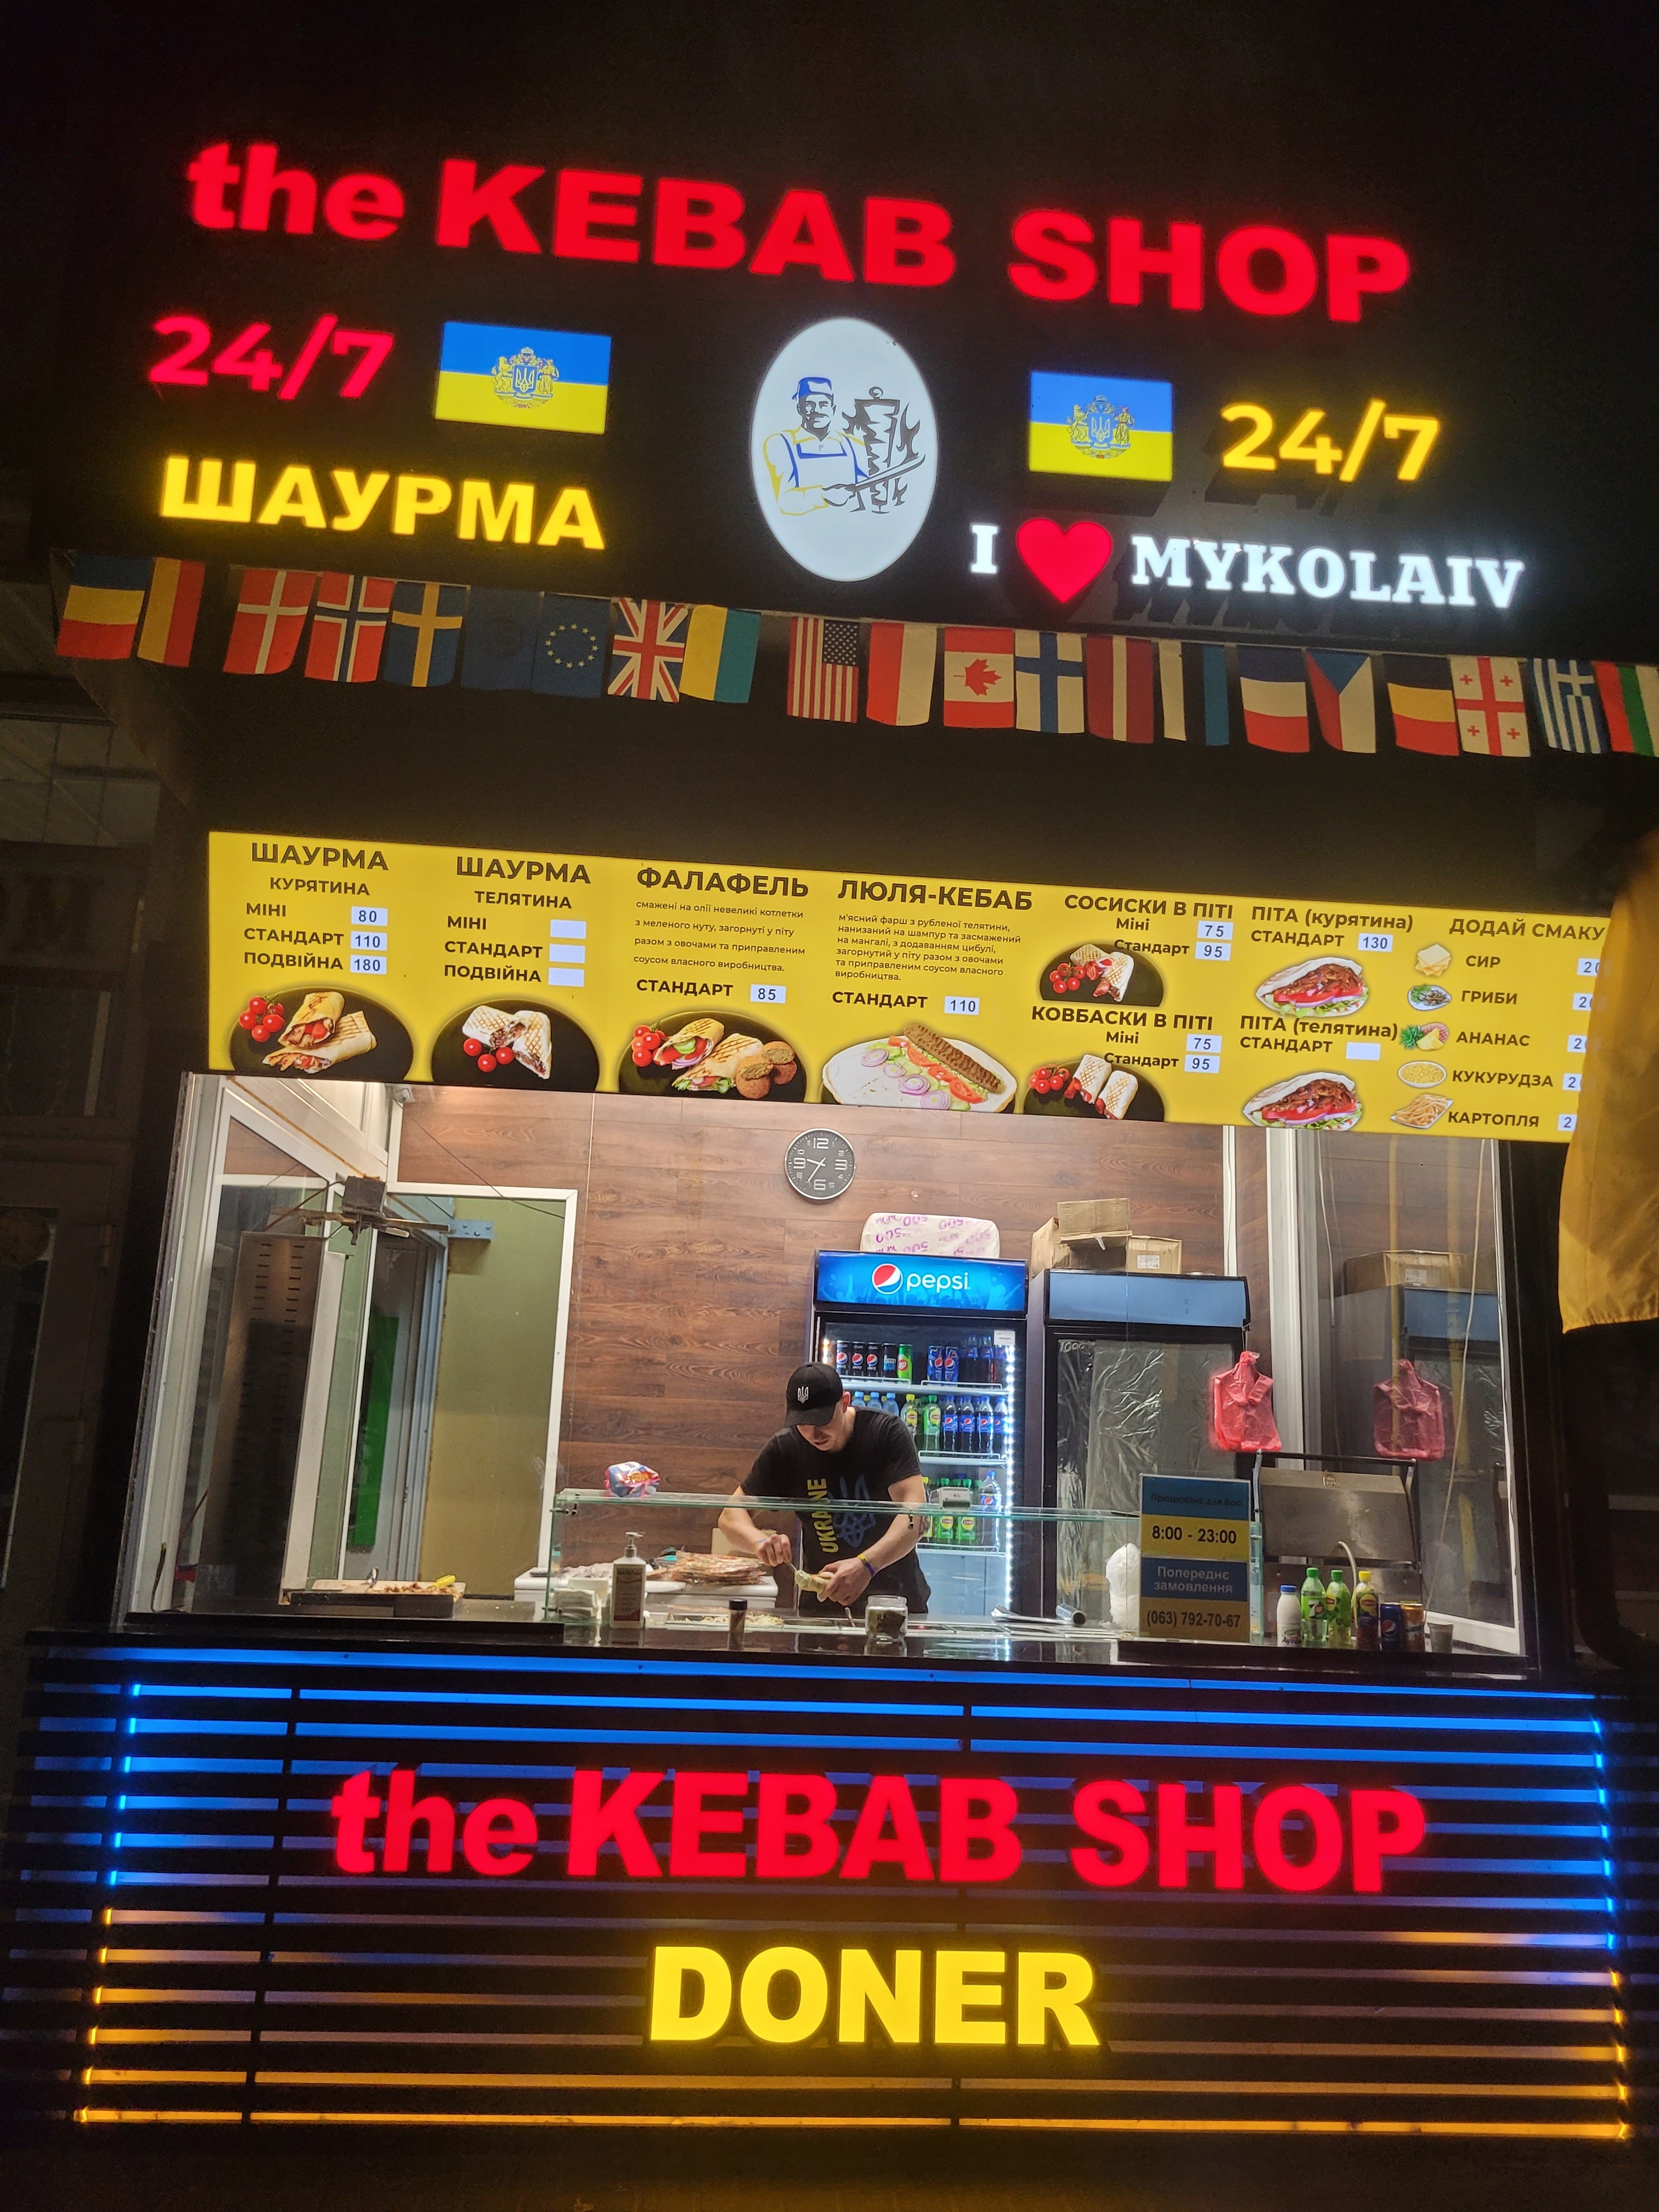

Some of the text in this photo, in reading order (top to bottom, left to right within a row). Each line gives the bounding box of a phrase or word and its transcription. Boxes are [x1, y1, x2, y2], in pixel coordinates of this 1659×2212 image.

[187, 143, 1409, 323] the KEBAB SHOP
[148, 314, 393, 401] 24/7
[1220, 398, 1442, 483] 24/7
[159, 455, 605, 550] ШАУРМА
[970, 523, 1523, 610] I MYKOLAIV
[251, 842, 388, 871] ШАУРМА
[456, 856, 591, 884] ШАУРМА
[270, 878, 370, 896] КУРЯТИНА
[637, 867, 809, 897] ФАЛАФЕЛЬ
[474, 891, 572, 909] ТЕЛЯТИНА
[838, 879, 1032, 910] ЛЮЛЯ-КЕБАБ
[246, 902, 377, 923] МІНІ 80
[636, 901, 677, 910] смажені
[694, 903, 710, 912] олії
[714, 906, 757, 915] невеликі
[760, 909, 803, 918] котлетки
[1065, 894, 1233, 919] СОСИСКИ В ПІТІ
[447, 916, 487, 930] МІНІ
[643, 920, 690, 929] меленого
[693, 923, 716, 932] нуту,
[719, 924, 765, 934] загорнуті
[775, 927, 794, 937] піту
[839, 914, 877, 923] м'ясний
[880, 916, 907, 926] фарш
[917, 918, 961, 928] рубленої
[963, 922, 1010, 932] телятини,
[1116, 917, 1224, 937] Міні 75
[1251, 906, 1413, 933] ПІТА (курятина)
[244, 927, 381, 949] СТАНДАРТ 110
[838, 926, 891, 934] нанизаний
[907, 930, 946, 940] шампур
[961, 933, 1021, 944] засмажений
[1449, 918, 1606, 941] ДОДАЙ СМАКУ
[851, 937, 890, 947] мангалі,
[900, 941, 960, 951] додаванням
[962, 944, 996, 953] цибулі,
[1114, 939, 1222, 958] Стандарт 95
[1251, 930, 1388, 949] СТАНДАРТ 130
[444, 940, 543, 959] СТАНДАРТ
[732, 944, 805, 955] приправленим
[836, 947, 891, 958] загорнутий
[894, 951, 900, 960] у
[902, 951, 921, 961] піту
[923, 953, 952, 962] разом
[962, 956, 1003, 964] овочами
[244, 952, 380, 972] ПОДВІЙНА 180
[634, 956, 785, 972] соусом власного виробництва.
[848, 960, 921, 972] приправленим
[923, 964, 957, 974] соусом
[960, 967, 1003, 976] власного
[1465, 955, 1501, 968] СИР
[444, 964, 541, 983] ПОДВІЙНА
[835, 970, 901, 981] виробництва.
[636, 979, 776, 1000] СТАНДАРТ 85
[1461, 990, 1517, 1005] ГРИБИ
[832, 991, 976, 1012] СТАНДАРТ 110
[1031, 1006, 1213, 1030] КОВБАСКИ В ПІТІ
[1240, 1015, 1398, 1041] ПІТА (телятина)
[1106, 1030, 1211, 1050] Міні 75
[1240, 1036, 1333, 1053] СТАНДАРТ
[1456, 1031, 1531, 1047] АНАНАС
[1104, 1052, 1210, 1070] Стандарт 95
[1452, 1070, 1554, 1088] КУКУРУДЗА
[1448, 1111, 1539, 1127] КАРТОПЛЯ
[813, 1138, 828, 1149] 12
[793, 1158, 805, 1169] 9
[835, 1159, 847, 1170] 3
[814, 1179, 826, 1190] 6
[907, 1272, 968, 1293] pepsi
[808, 1479, 838, 1553] UKRANE
[1152, 1526, 1182, 1540] 8:00
[1198, 1529, 1236, 1544] 23:00
[1158, 1566, 1229, 1580] Попереднє
[1154, 1581, 1232, 1593] замовлення
[1147, 1611, 1241, 1627] (063) 792-70-67
[331, 1769, 1426, 1893] the KEBAB SHOP
[650, 1945, 1099, 2046] DONER
